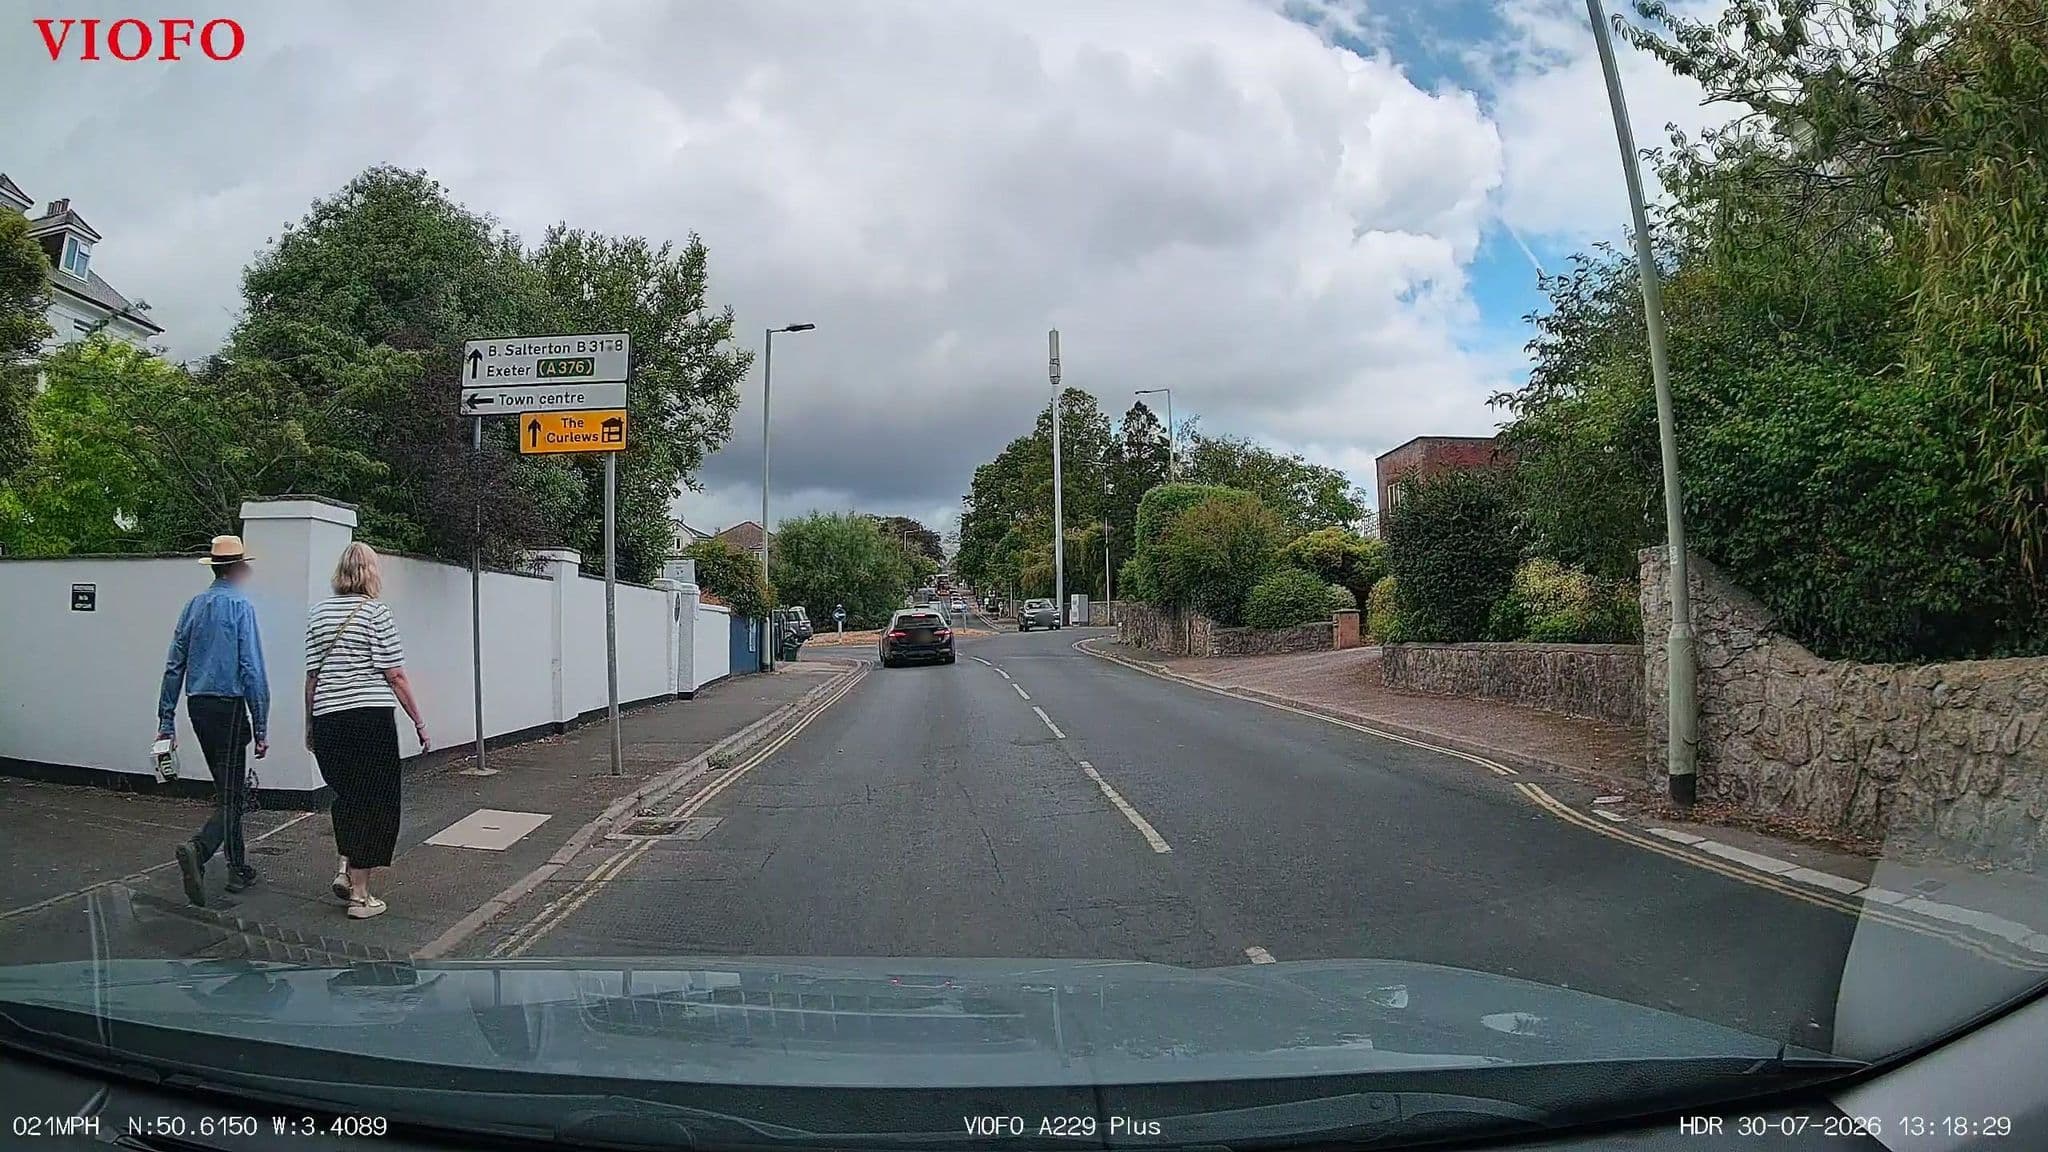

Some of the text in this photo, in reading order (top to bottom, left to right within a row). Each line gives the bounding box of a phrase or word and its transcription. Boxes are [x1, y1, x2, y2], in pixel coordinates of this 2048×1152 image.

[488, 346, 501, 357] B.
[504, 343, 571, 356] Salterton
[486, 360, 593, 377] Exeter (A376)
[499, 392, 585, 406] Town centre
[561, 417, 584, 428] The
[546, 432, 599, 443] Curlews
